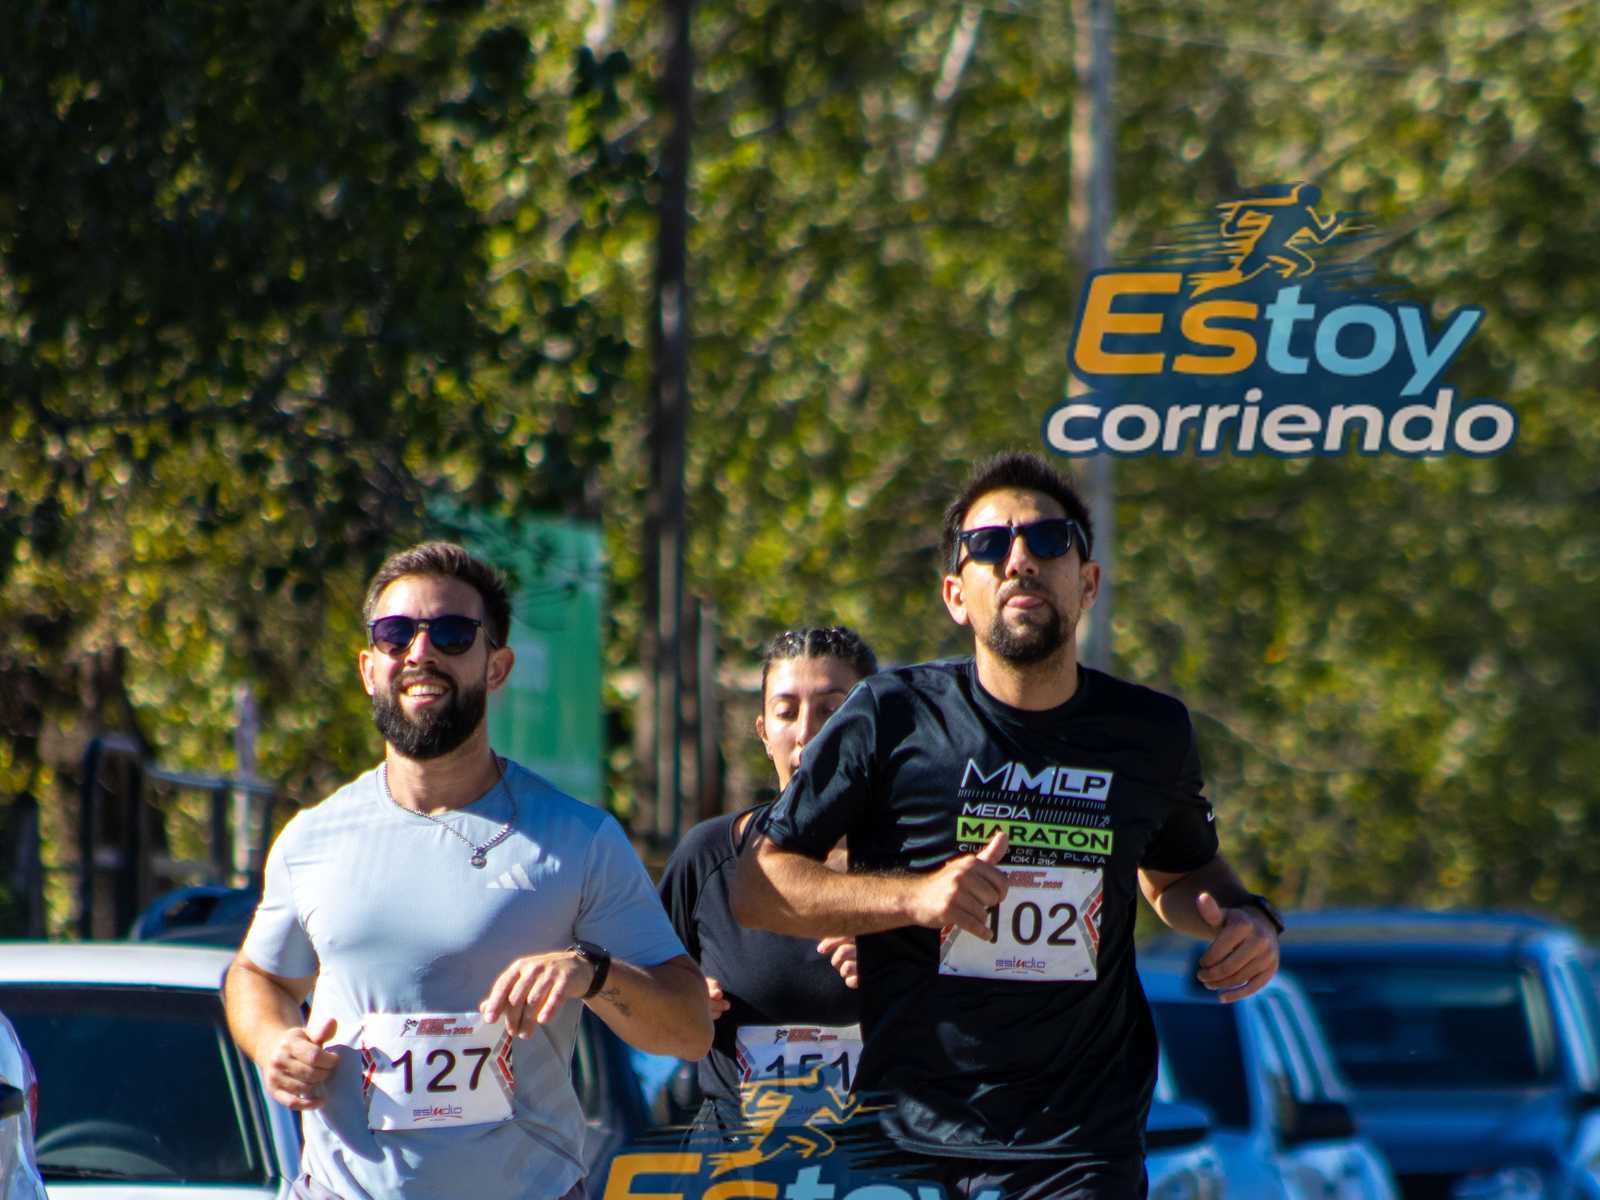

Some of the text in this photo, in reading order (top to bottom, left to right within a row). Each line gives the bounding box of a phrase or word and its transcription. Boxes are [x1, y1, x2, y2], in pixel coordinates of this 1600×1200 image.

[960, 758, 1113, 801] MMLP
[961, 802, 1032, 821] MEDIA
[1039, 850, 1058, 859] LA
[1063, 852, 1106, 865] PLATA
[986, 901, 1077, 945] 102
[391, 1047, 492, 1094] 127
[765, 1051, 850, 1093] 151
